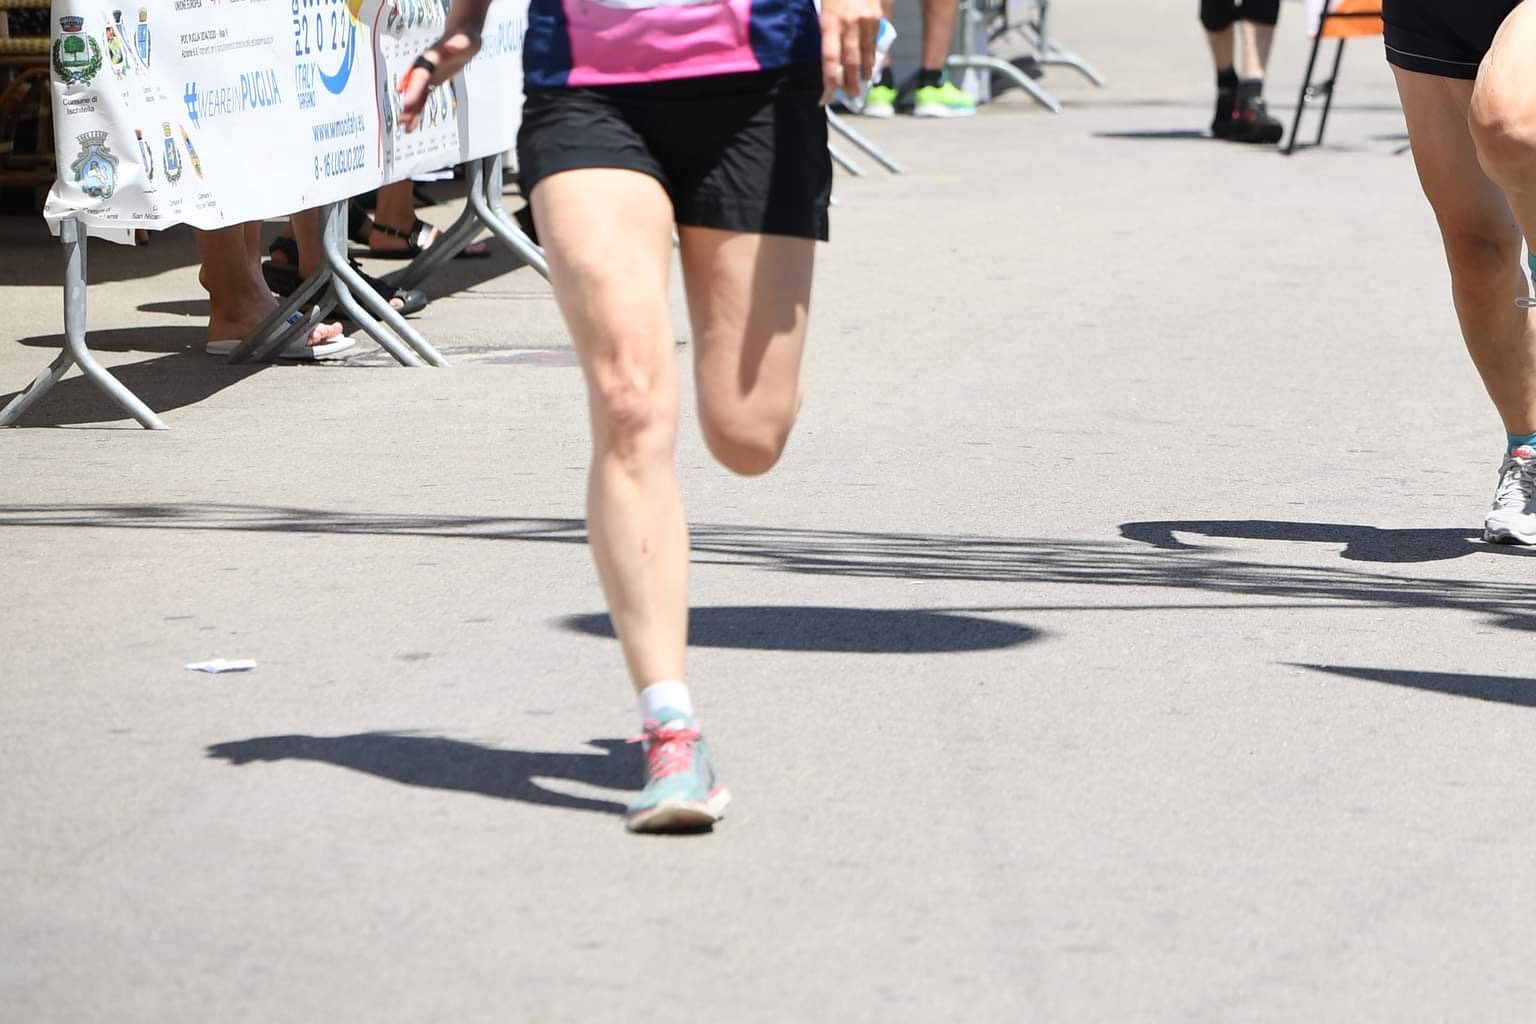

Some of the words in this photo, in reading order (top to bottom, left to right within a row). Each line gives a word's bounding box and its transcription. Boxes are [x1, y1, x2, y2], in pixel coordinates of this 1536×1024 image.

[294, 63, 316, 90] ITALY
[63, 97, 91, 107] Comune
[91, 95, 98, 105] di
[184, 69, 281, 129] #WEAREINPUGLIA
[314, 155, 320, 180] 8
[331, 147, 353, 176] LUGLIO
[352, 143, 365, 171] 2022
